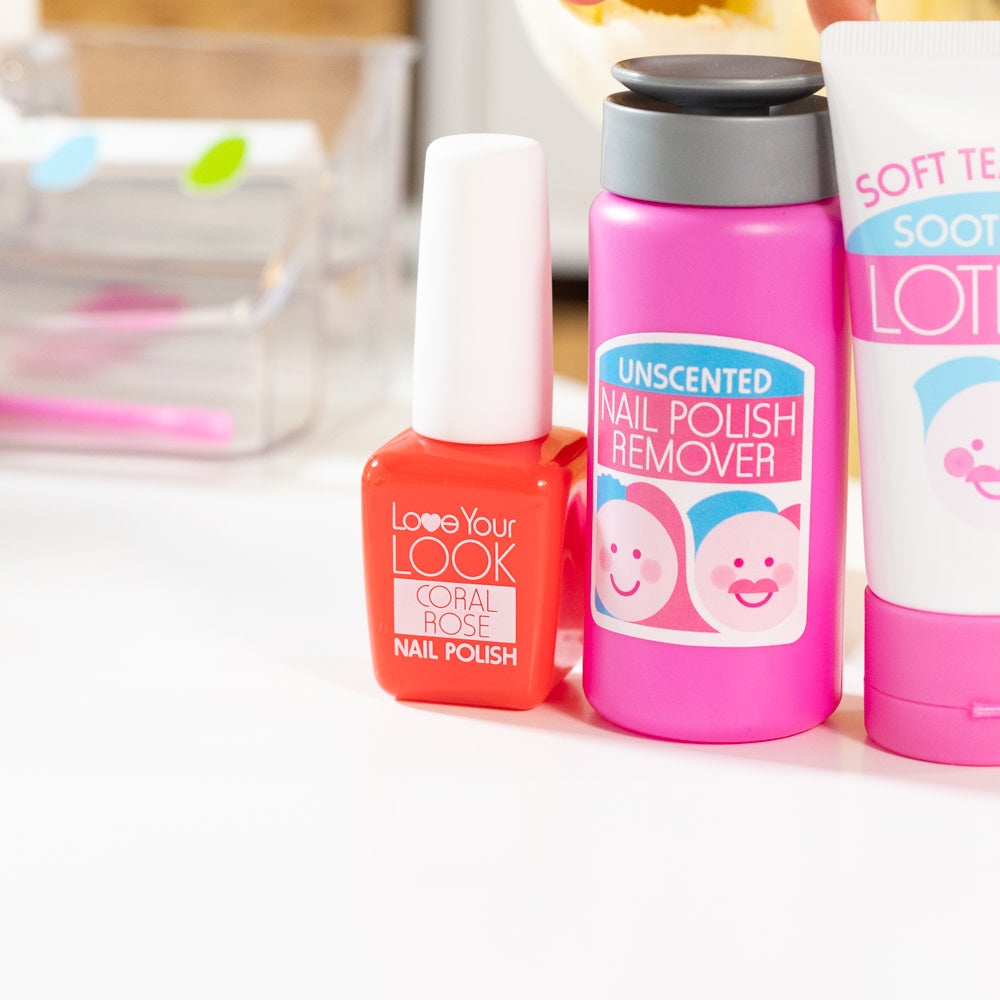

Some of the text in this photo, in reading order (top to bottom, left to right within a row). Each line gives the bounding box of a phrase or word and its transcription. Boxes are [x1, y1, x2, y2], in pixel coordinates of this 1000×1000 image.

[855, 151, 946, 208] SOFT
[618, 356, 772, 394] UNSCENTED
[601, 386, 796, 439] NAIL POLISH
[612, 429, 775, 478] REMOVER
[460, 506, 516, 538] Your
[392, 534, 516, 583] LOOK
[416, 584, 497, 612] CORAL
[424, 611, 489, 638] ROSE
[394, 637, 517, 666] NAIL POLISH
